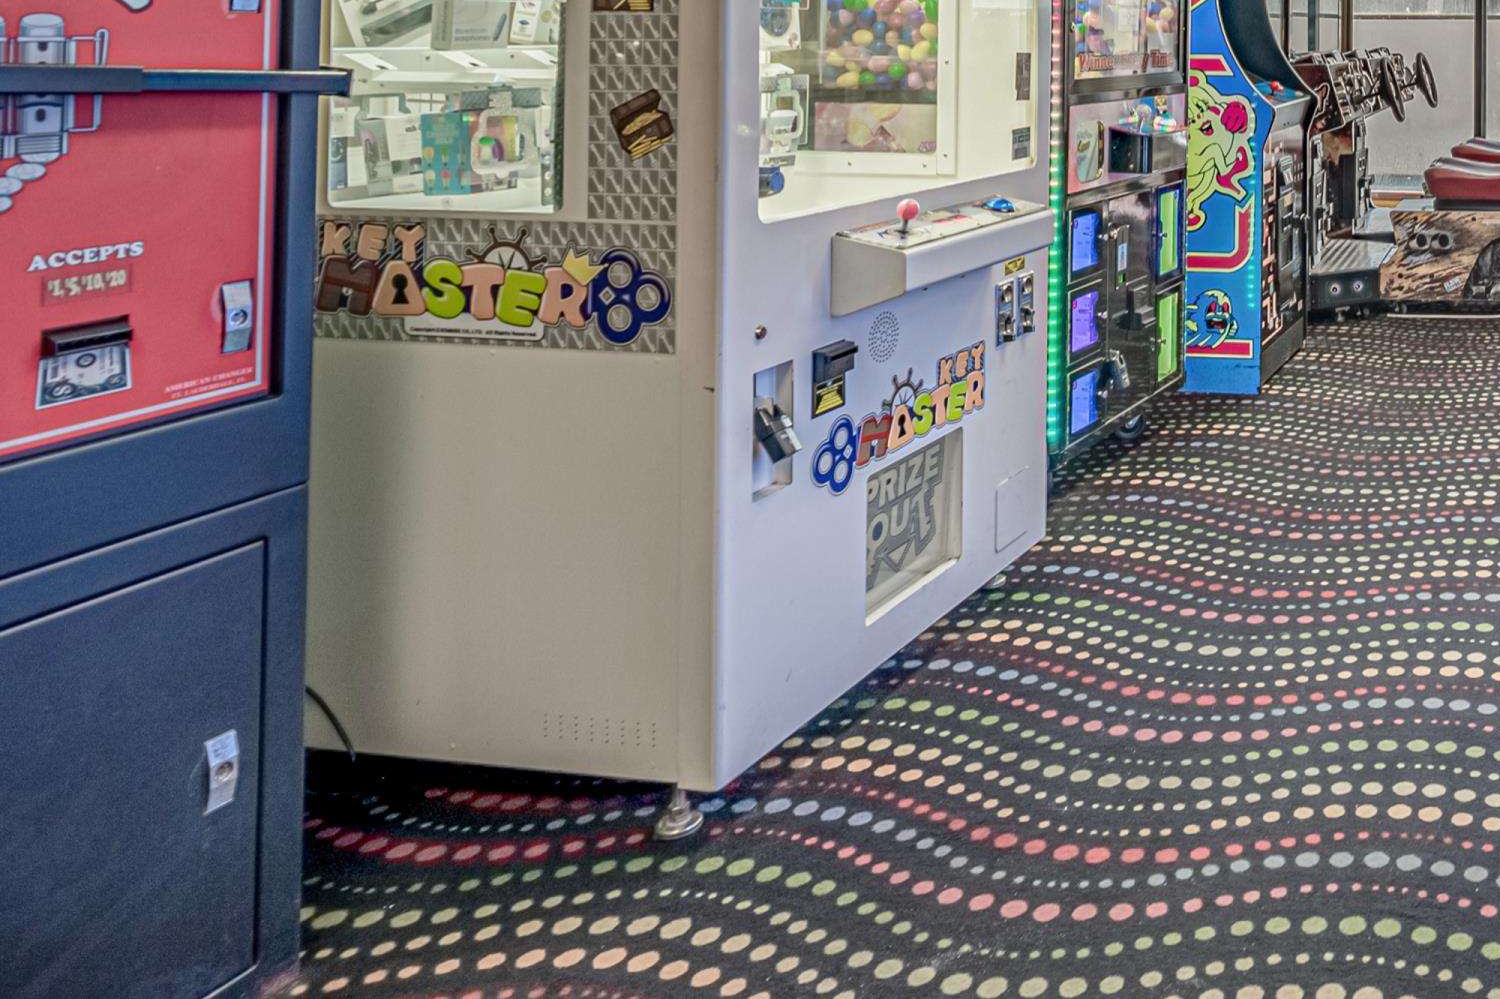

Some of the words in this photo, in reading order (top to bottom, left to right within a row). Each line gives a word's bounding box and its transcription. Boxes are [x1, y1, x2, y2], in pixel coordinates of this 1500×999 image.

[27, 241, 144, 272] ACCEPTS
[321, 222, 425, 263] KEY
[316, 256, 589, 328] MASTER
[939, 342, 985, 385] KEY
[856, 370, 985, 467] MASTER
[867, 443, 942, 509] PRIZE
[868, 487, 935, 548] OUT
